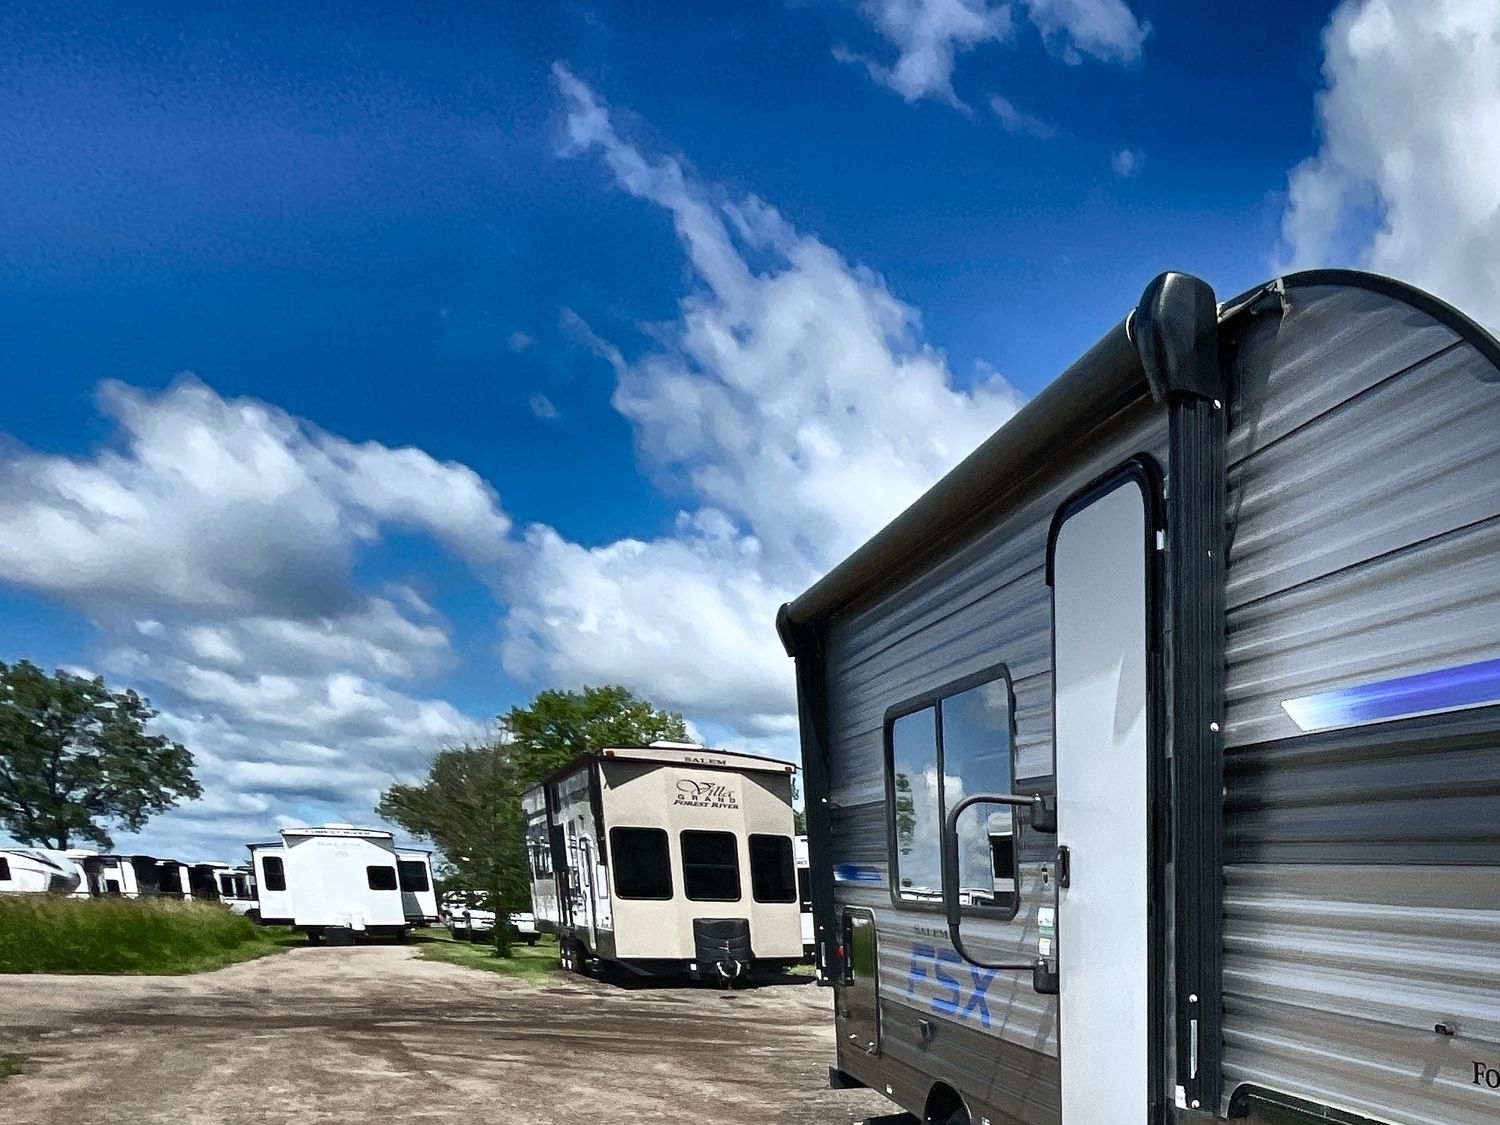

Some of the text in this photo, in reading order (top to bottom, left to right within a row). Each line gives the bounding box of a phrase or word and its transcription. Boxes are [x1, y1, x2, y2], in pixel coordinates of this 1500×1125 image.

[684, 756, 727, 765] SALEM
[676, 779, 735, 798] Villa
[673, 799, 739, 810] FOREST RIVER
[677, 793, 736, 804] GRAND
[913, 924, 948, 940] SALEM
[905, 942, 999, 1029] FSX
